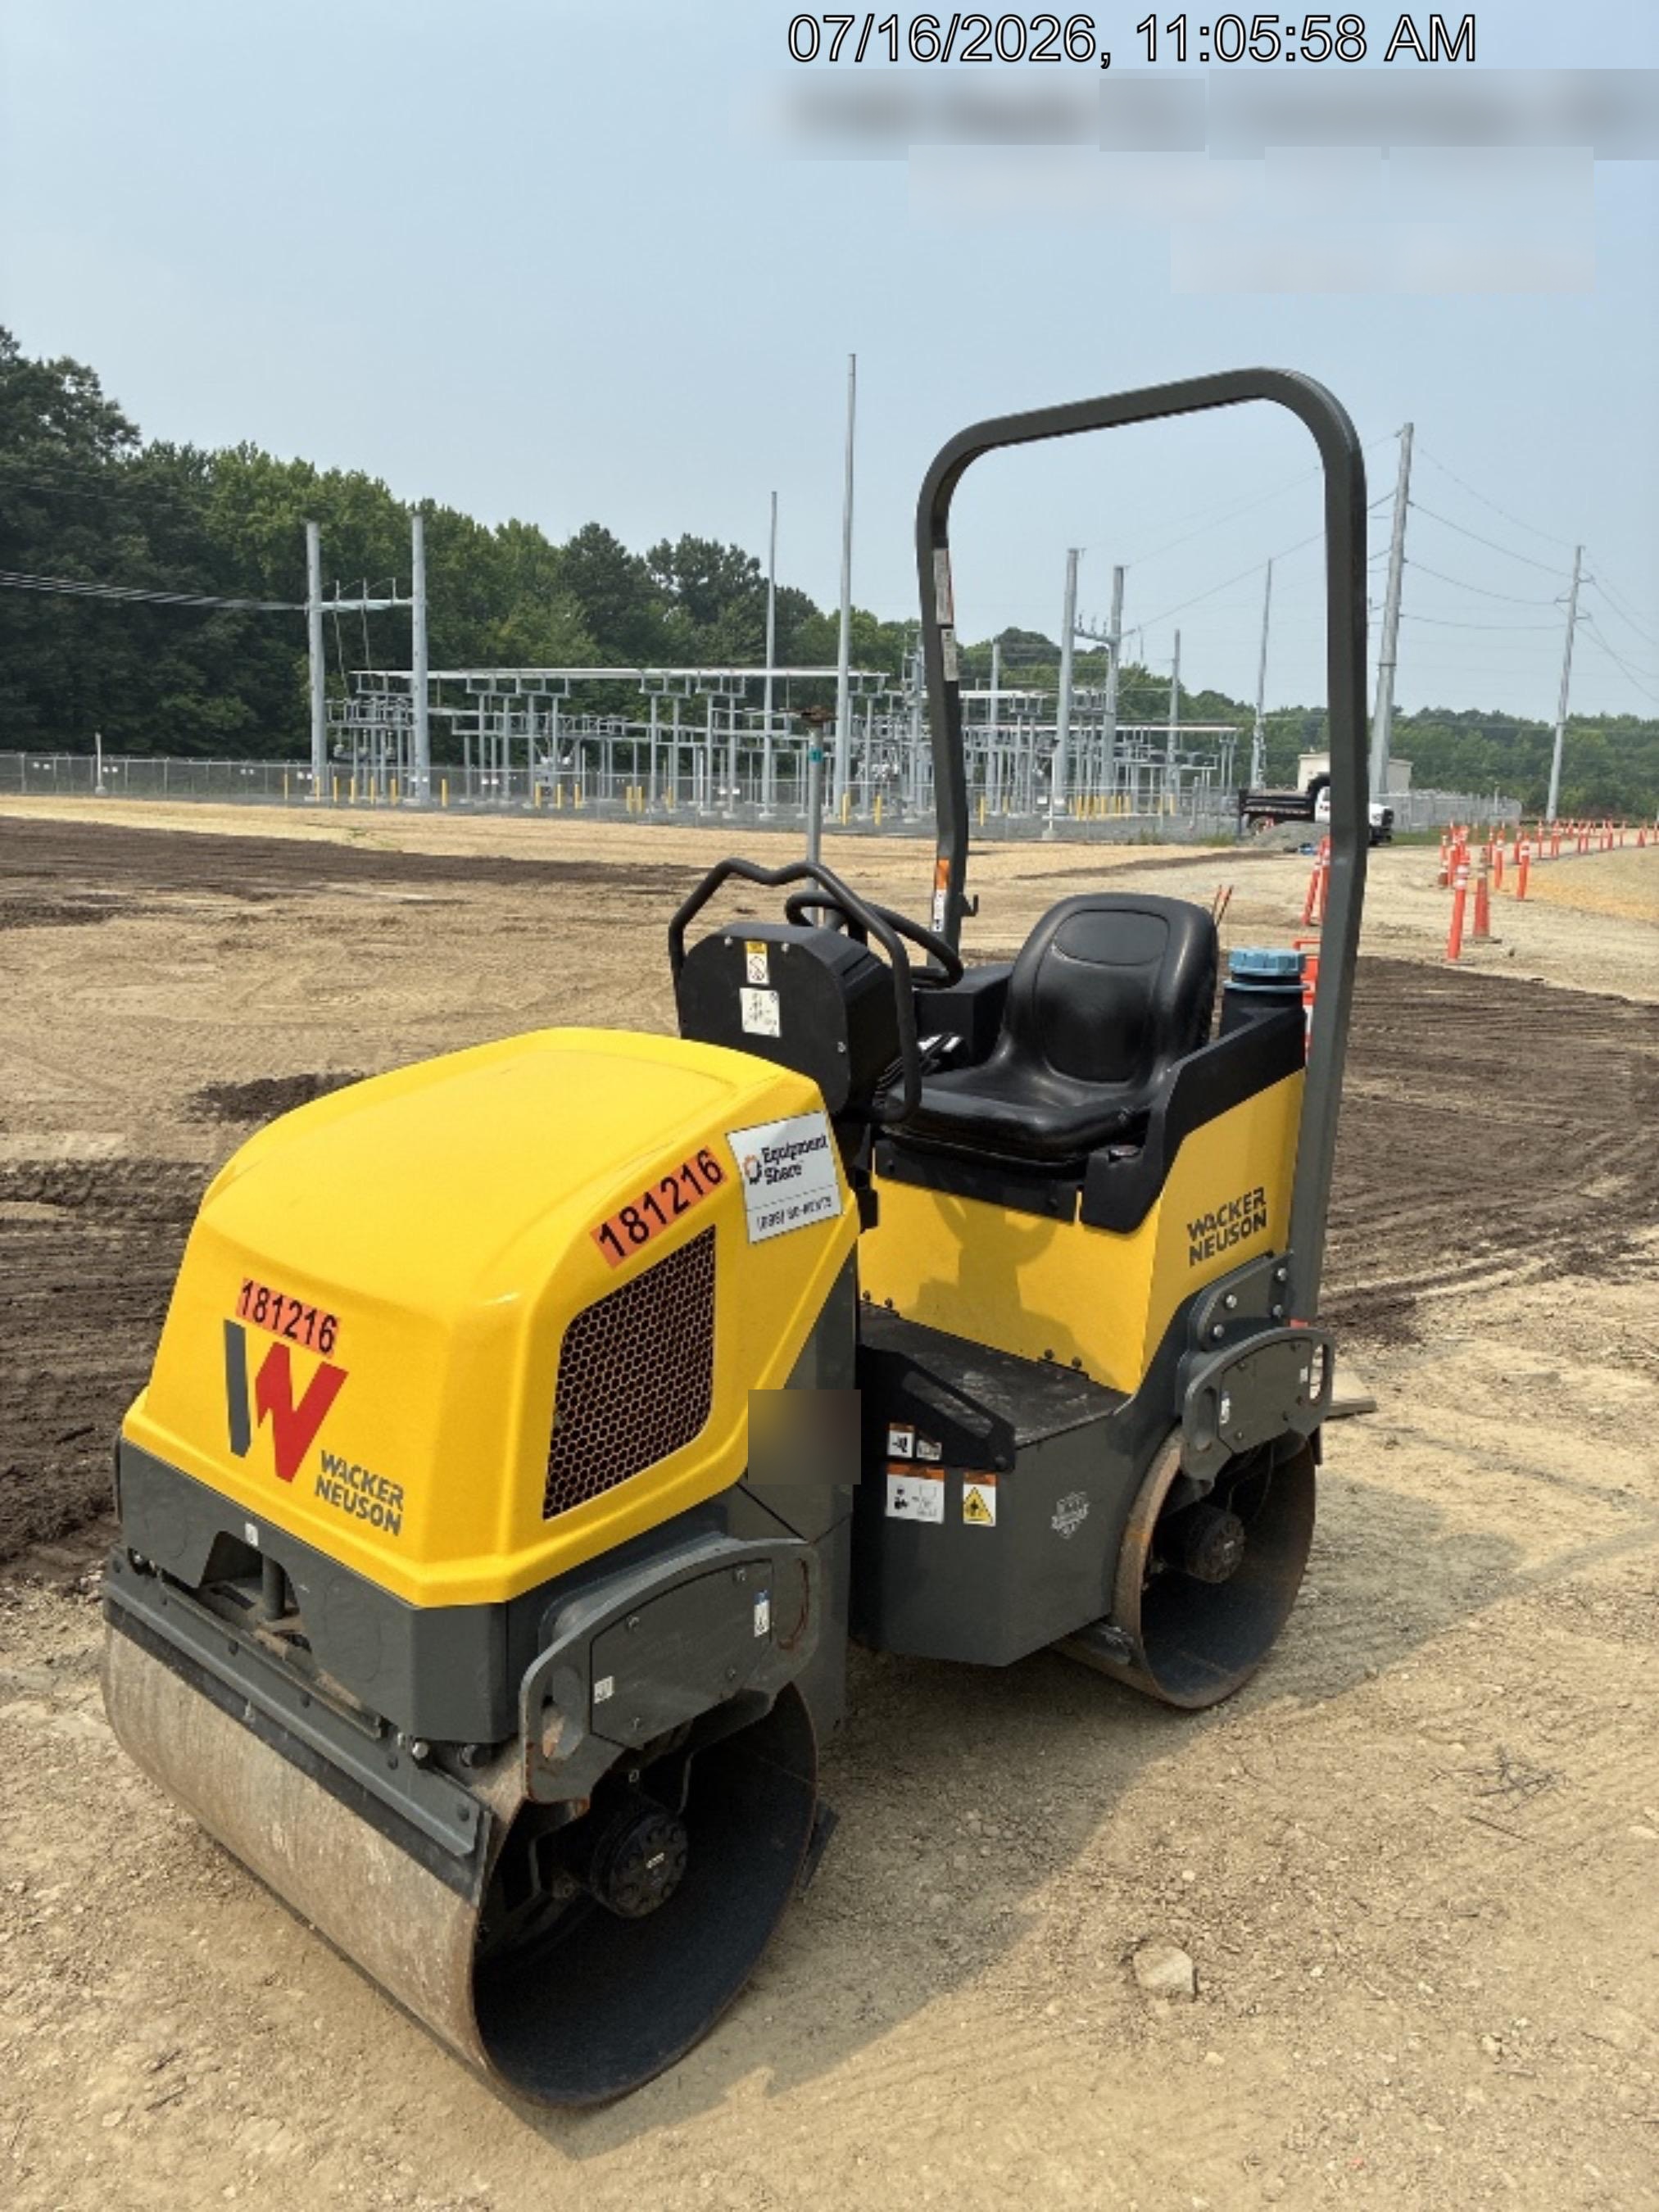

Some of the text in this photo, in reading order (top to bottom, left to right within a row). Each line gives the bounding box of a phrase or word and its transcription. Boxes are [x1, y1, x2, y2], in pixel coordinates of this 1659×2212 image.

[599, 1149, 723, 1257] 181216
[1187, 1186, 1267, 1241] WACKER
[1189, 1208, 1267, 1267] NEUSON
[242, 1280, 338, 1354] 181216
[314, 1475, 401, 1536] NEUSON
[320, 1449, 405, 1512] WACKER
